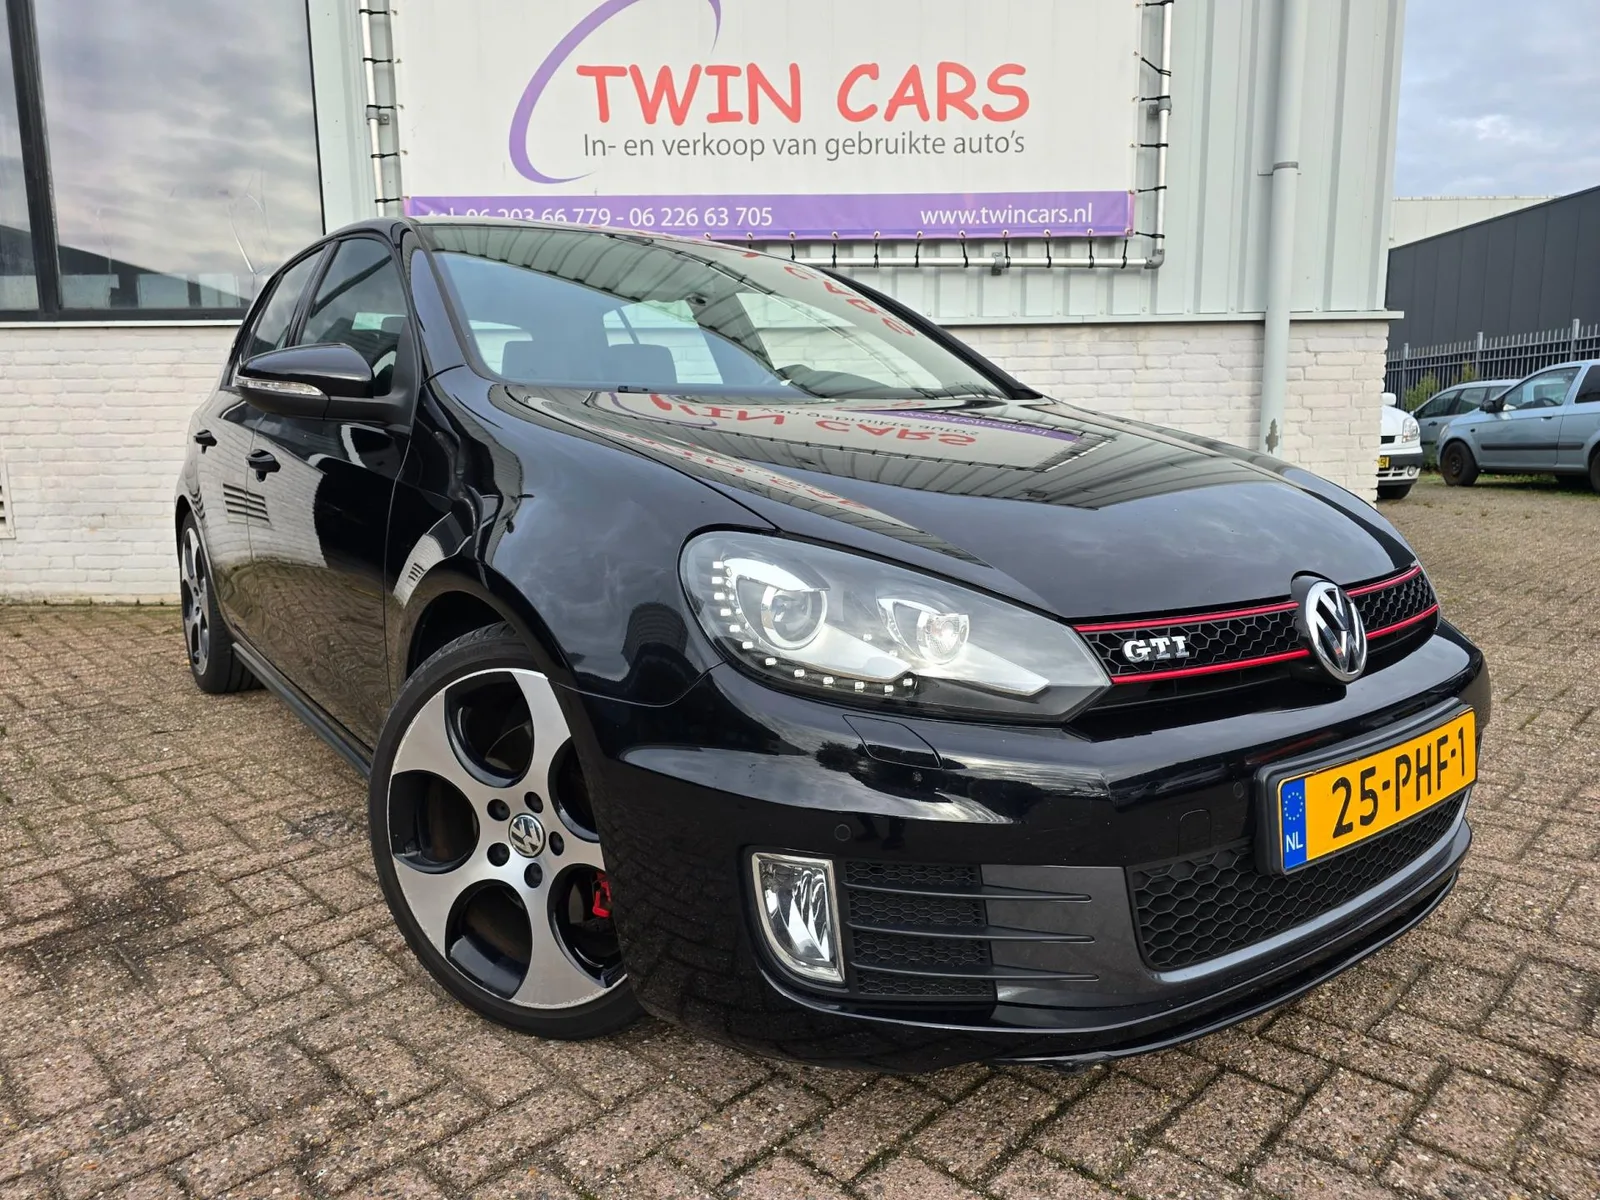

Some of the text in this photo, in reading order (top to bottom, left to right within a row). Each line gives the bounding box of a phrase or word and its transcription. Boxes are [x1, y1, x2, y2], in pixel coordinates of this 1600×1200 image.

[577, 62, 1030, 126] TWIN CARS
[584, 130, 1025, 162] In- en verkoop van gebruikte auto's
[542, 208, 567, 222] 66
[573, 208, 612, 226] 779
[629, 208, 656, 227] 06
[661, 208, 699, 227] 226
[704, 207, 729, 227] 63
[736, 207, 773, 226] 705
[920, 202, 1093, 225] www.twincars.nl
[1123, 635, 1190, 663] GTI
[1331, 726, 1465, 839] 25-PHF-1
[1286, 831, 1304, 853] NL
